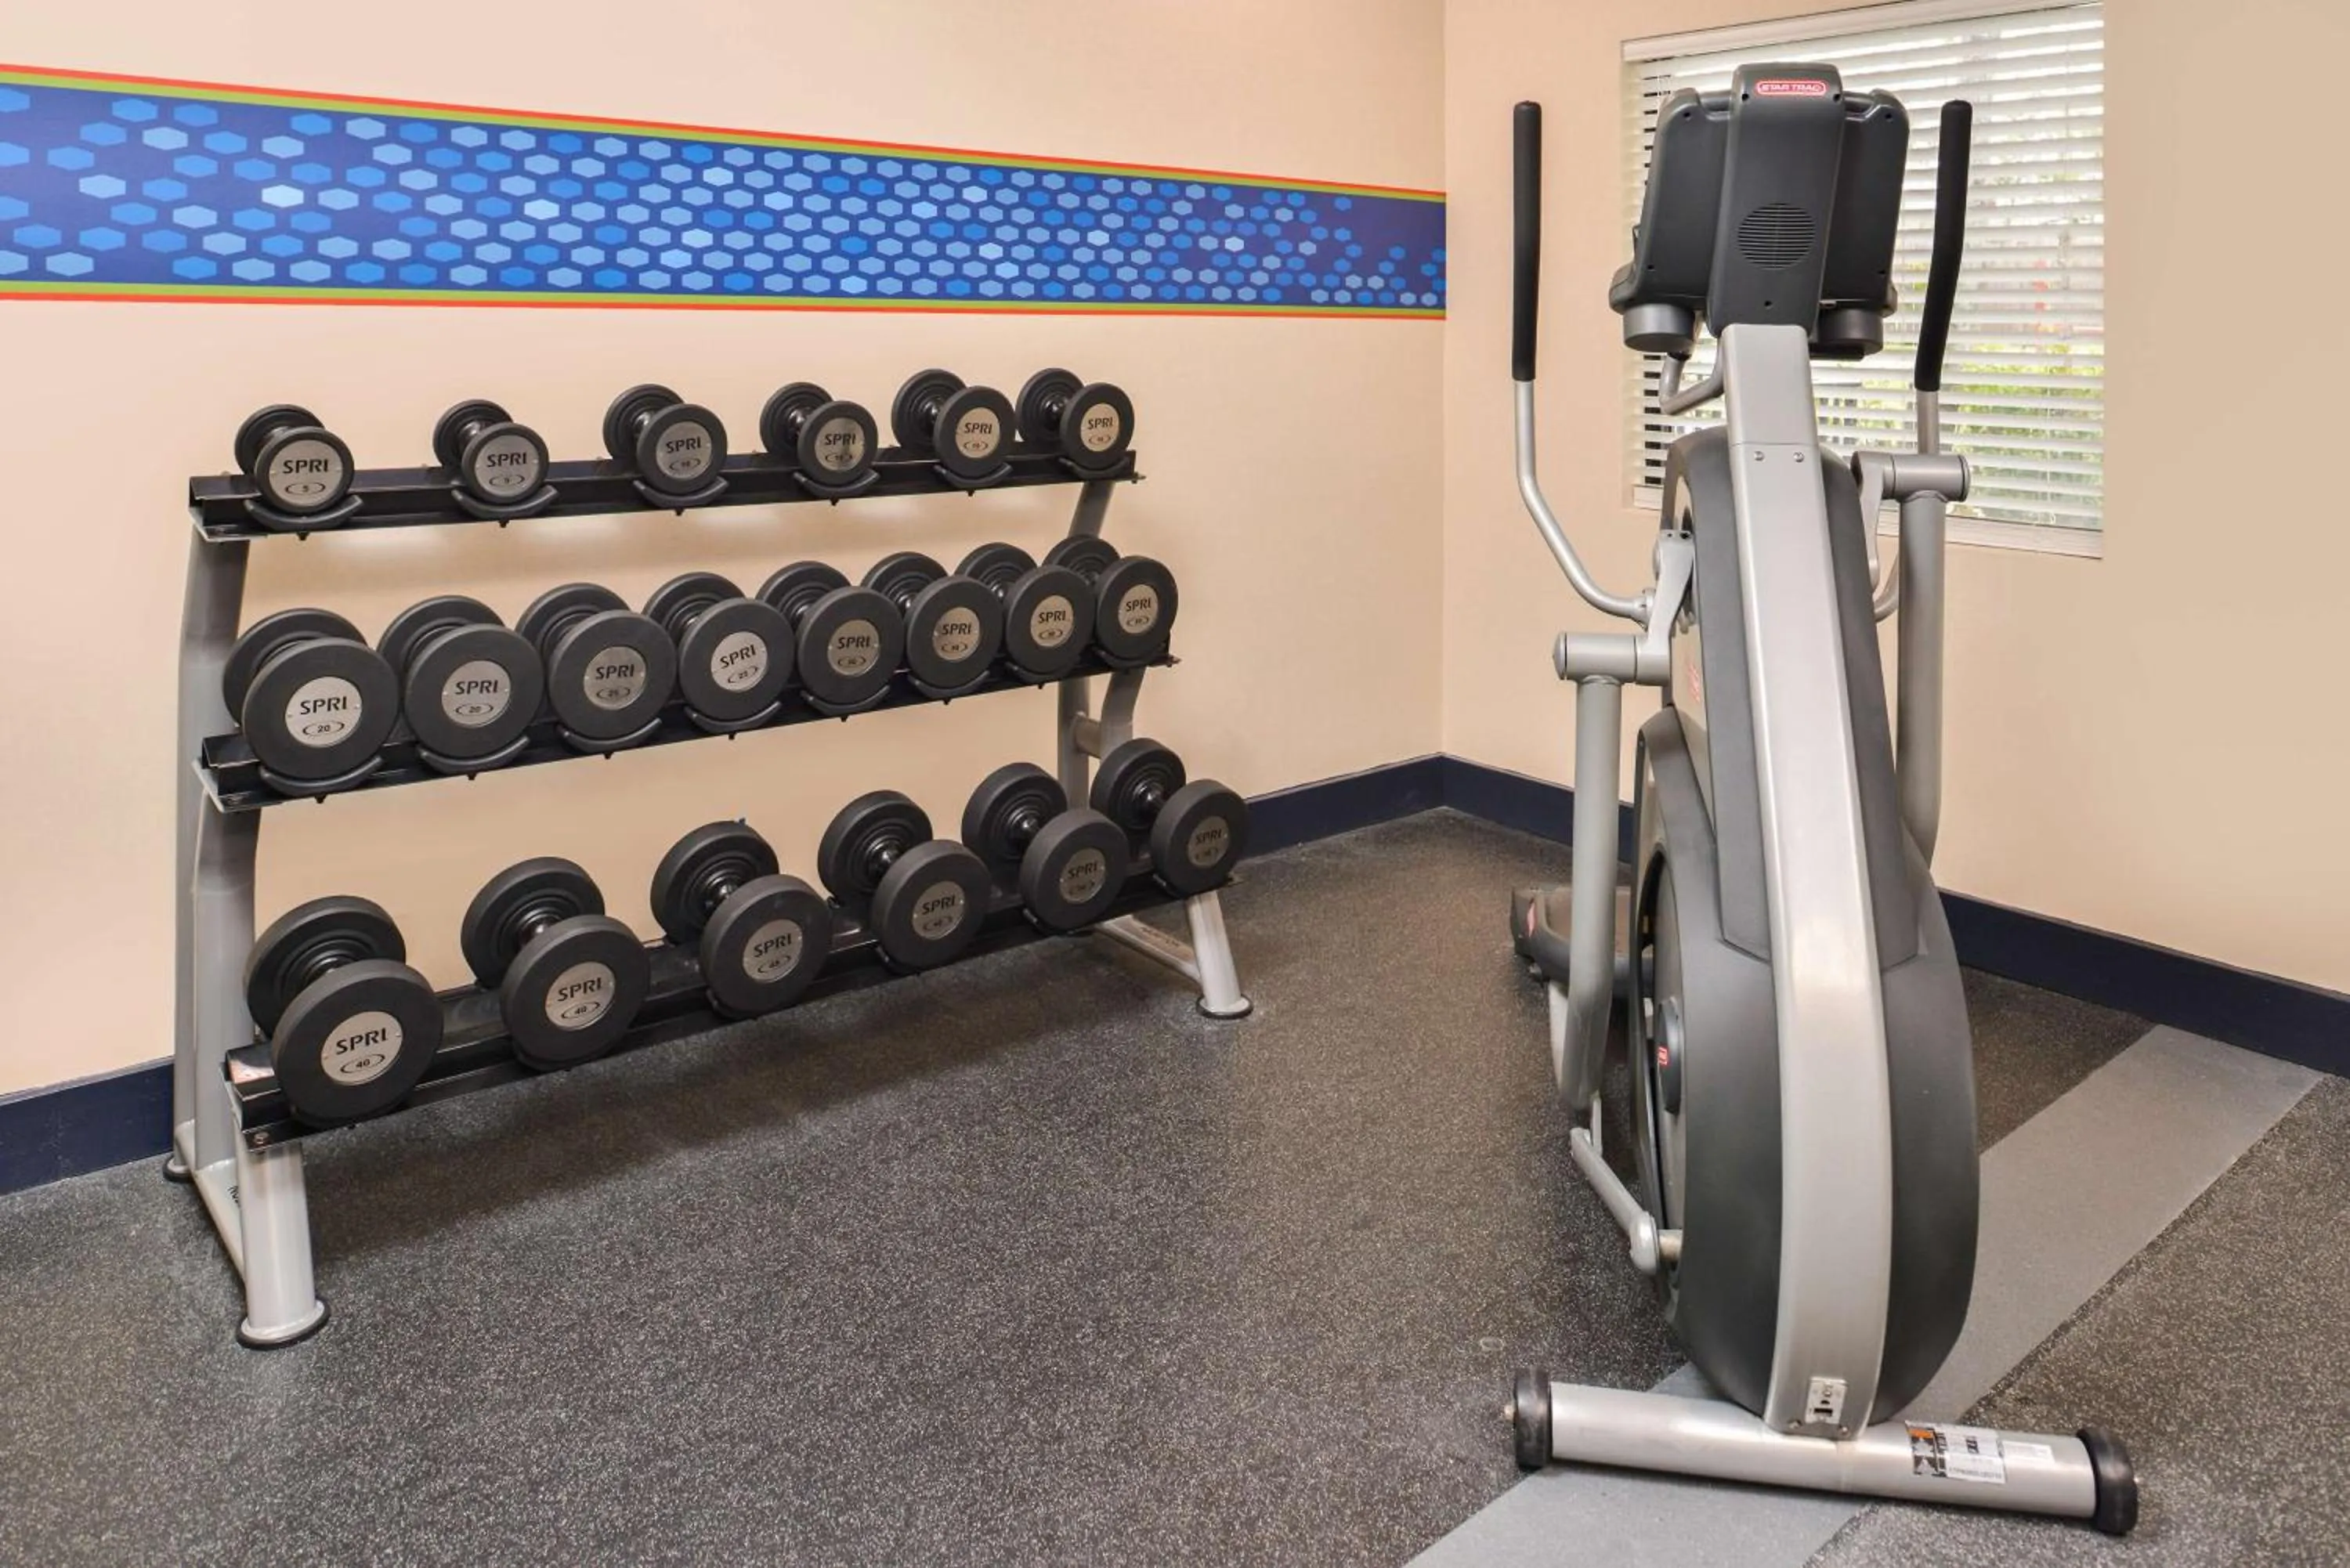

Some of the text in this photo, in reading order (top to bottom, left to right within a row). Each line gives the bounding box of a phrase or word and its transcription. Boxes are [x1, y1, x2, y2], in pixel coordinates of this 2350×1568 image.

[964, 422, 993, 435] SPRI
[1087, 417, 1113, 430] SPRI
[665, 436, 701, 453] SPRI
[825, 433, 856, 446] SPRI
[282, 459, 329, 474] SPRI
[486, 452, 527, 468] SPRI
[1126, 597, 1152, 612] SPRI
[1039, 610, 1066, 623] SPRI
[942, 623, 972, 635] SPRI
[837, 636, 870, 649] SPRI
[720, 645, 757, 670] SPRI
[595, 664, 634, 680] SPRI
[455, 680, 498, 695] SPRI
[300, 696, 347, 715] SPRI
[1195, 829, 1222, 845] SPRI
[1067, 862, 1097, 880] SPRI
[921, 895, 956, 916] SPRI
[754, 933, 792, 958] SPRI
[557, 977, 602, 1002] SPRI
[574, 1005, 587, 1015] 40
[336, 1028, 387, 1054] SPRI
[356, 1058, 371, 1068] 40
